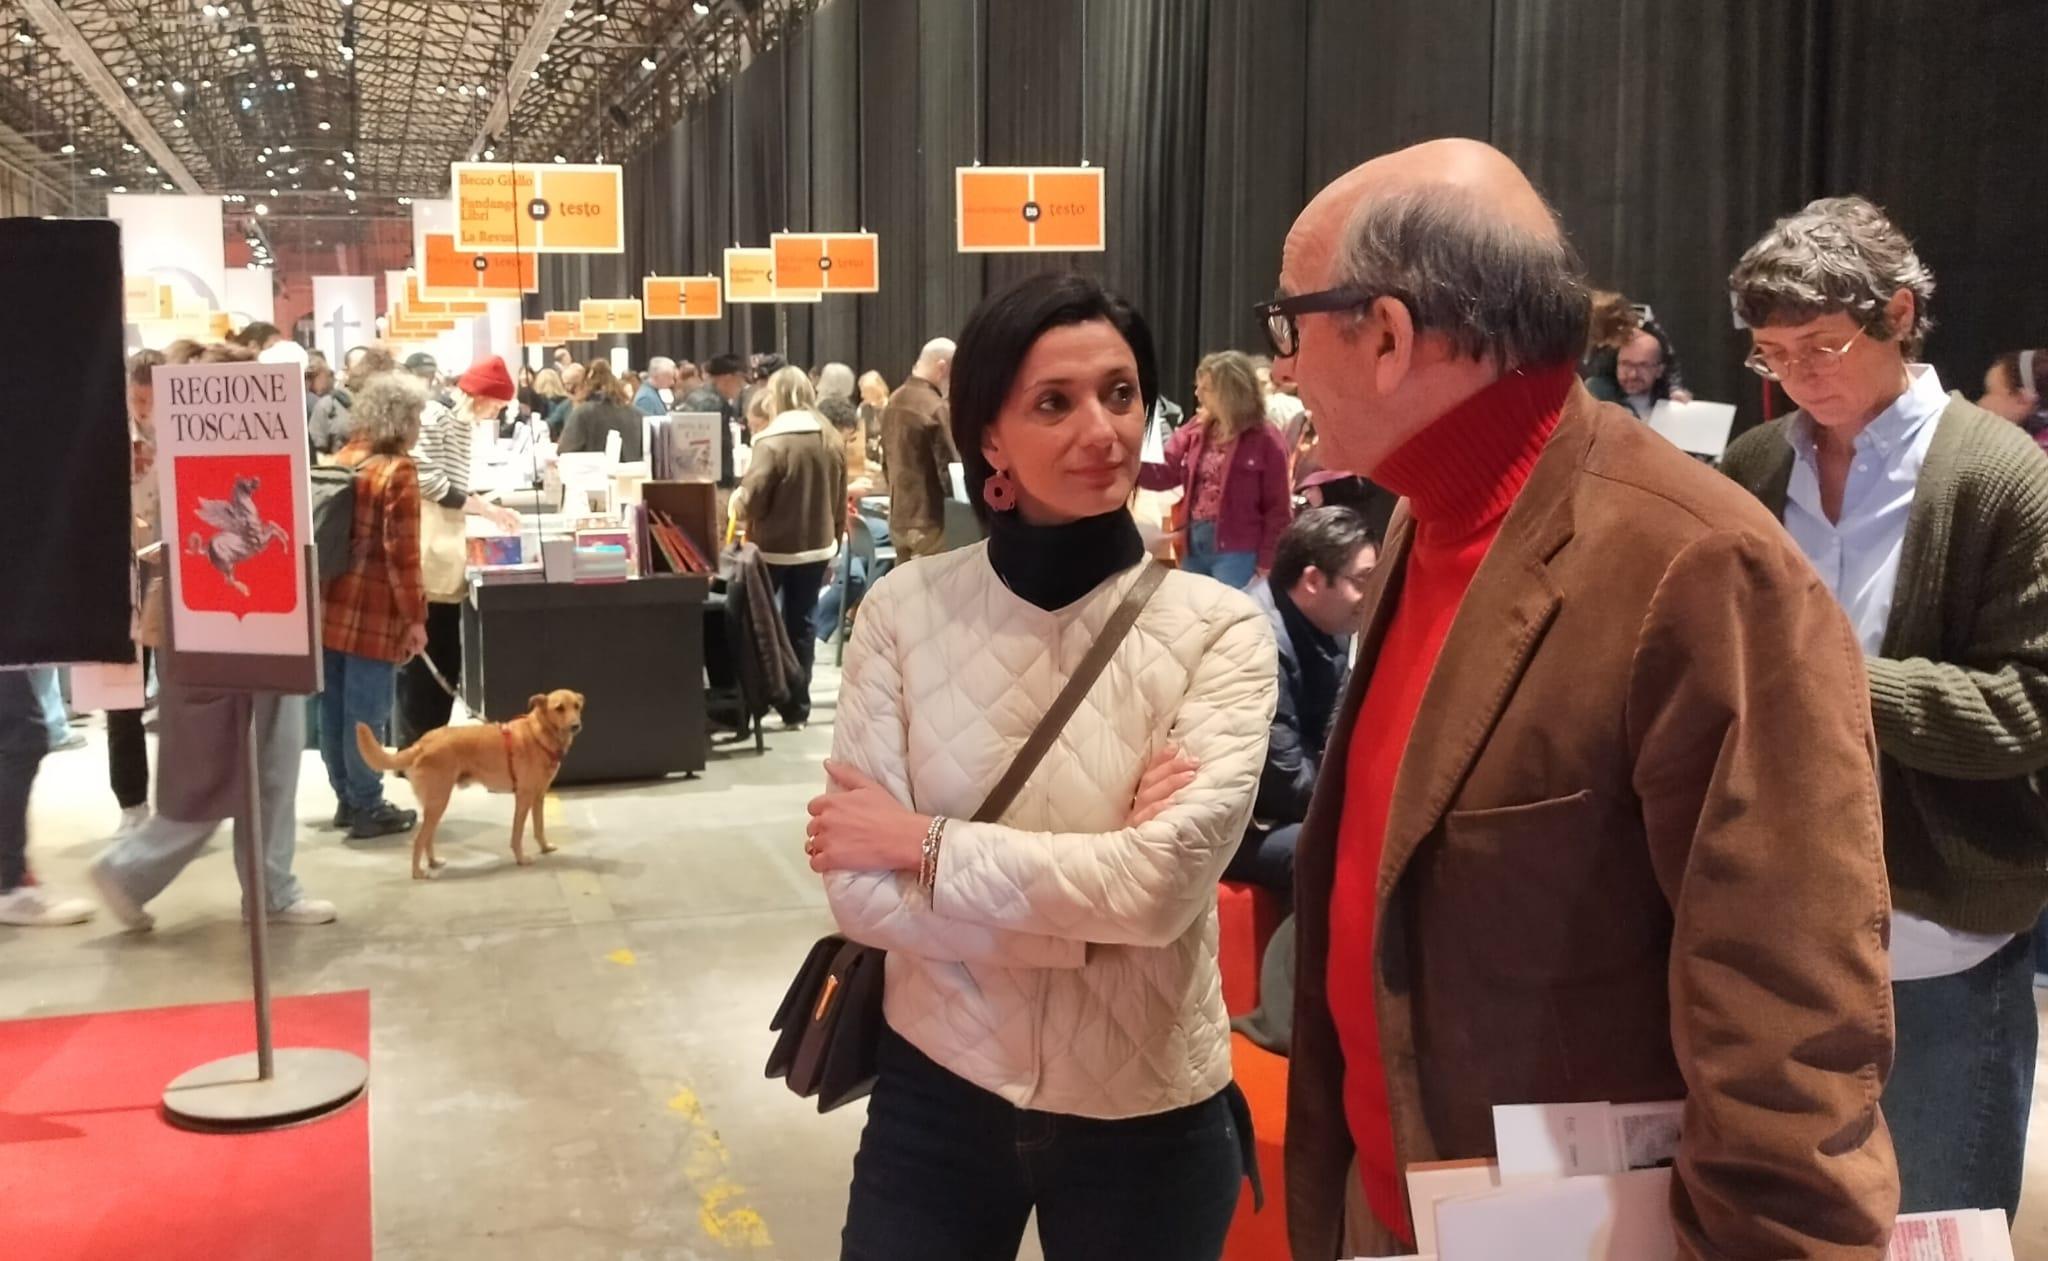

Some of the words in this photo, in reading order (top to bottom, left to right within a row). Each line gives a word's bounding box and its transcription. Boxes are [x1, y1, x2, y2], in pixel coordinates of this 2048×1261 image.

[460, 173, 494, 186] Becco
[498, 173, 534, 187] Giallo
[461, 208, 489, 221] Libri
[559, 201, 601, 217] testo
[1050, 202, 1086, 217] testo
[461, 230, 476, 242] La
[170, 373, 287, 405] REGIONE
[171, 411, 289, 442] TOSCANA
